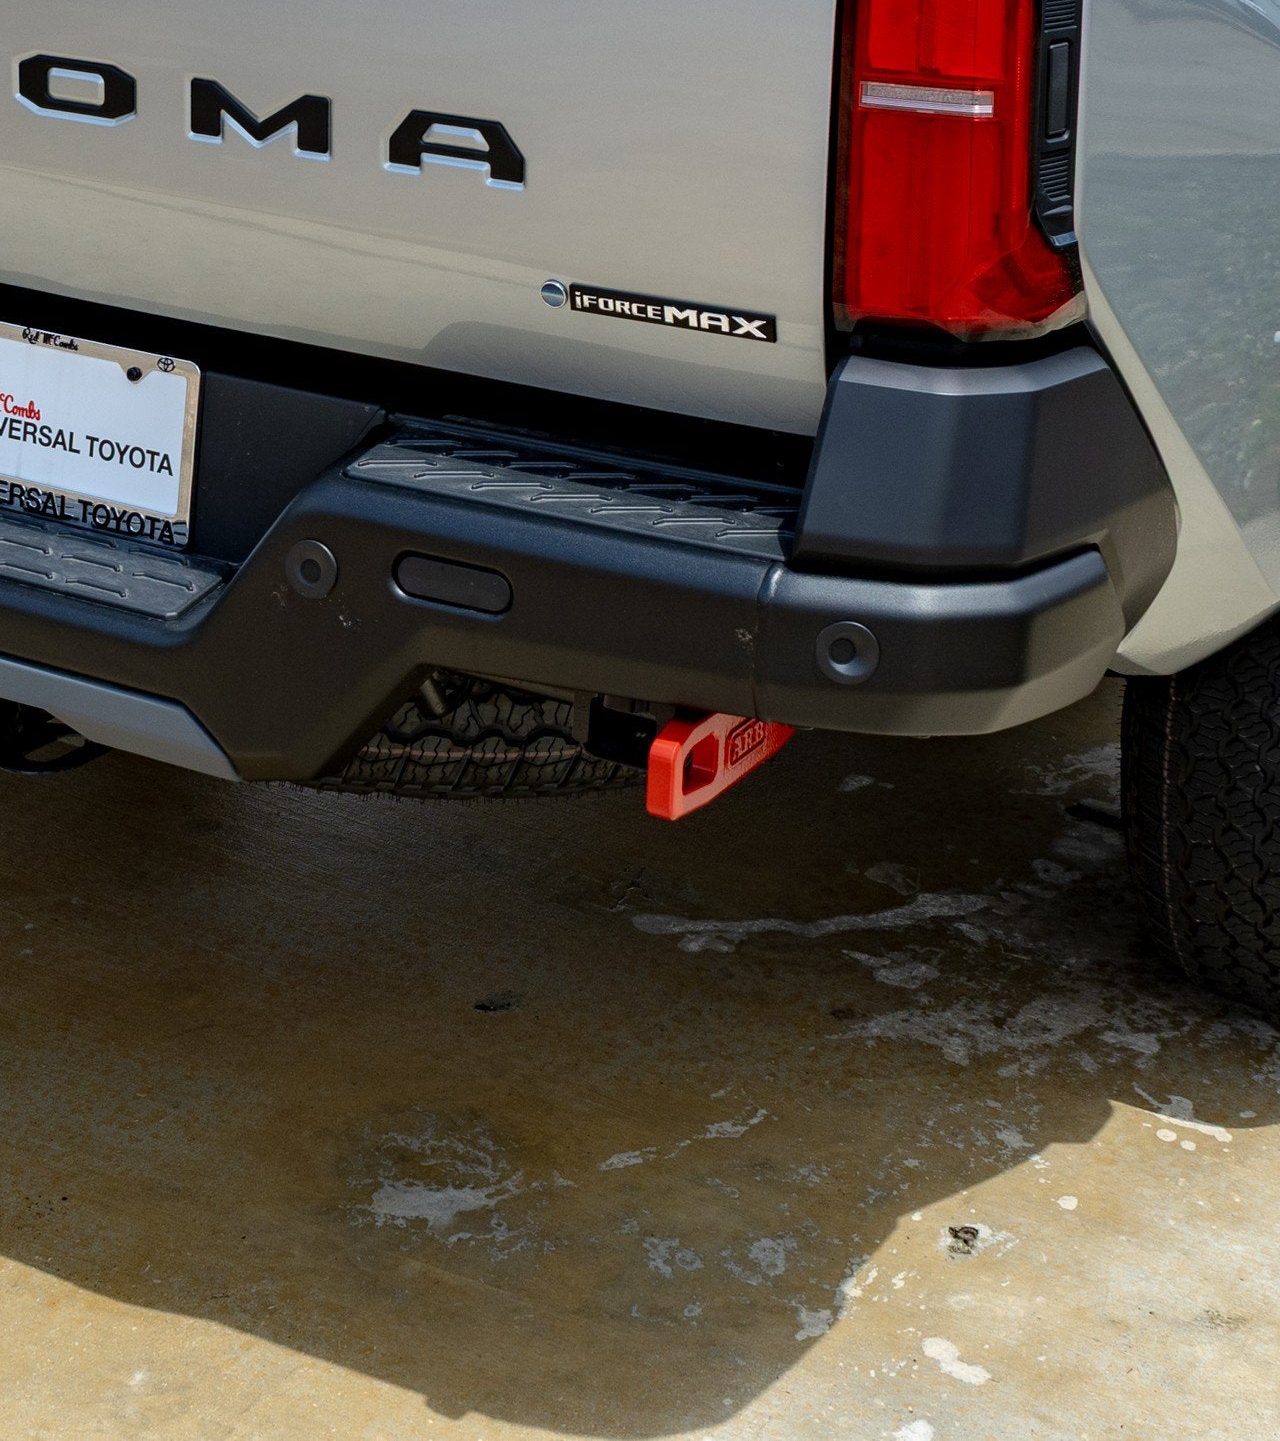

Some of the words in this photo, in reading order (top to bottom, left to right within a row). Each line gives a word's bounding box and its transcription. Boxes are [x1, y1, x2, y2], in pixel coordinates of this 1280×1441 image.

[85, 435, 174, 477] TOYOTA
[77, 498, 176, 546] TOYOTA
[732, 721, 766, 760] ARB
